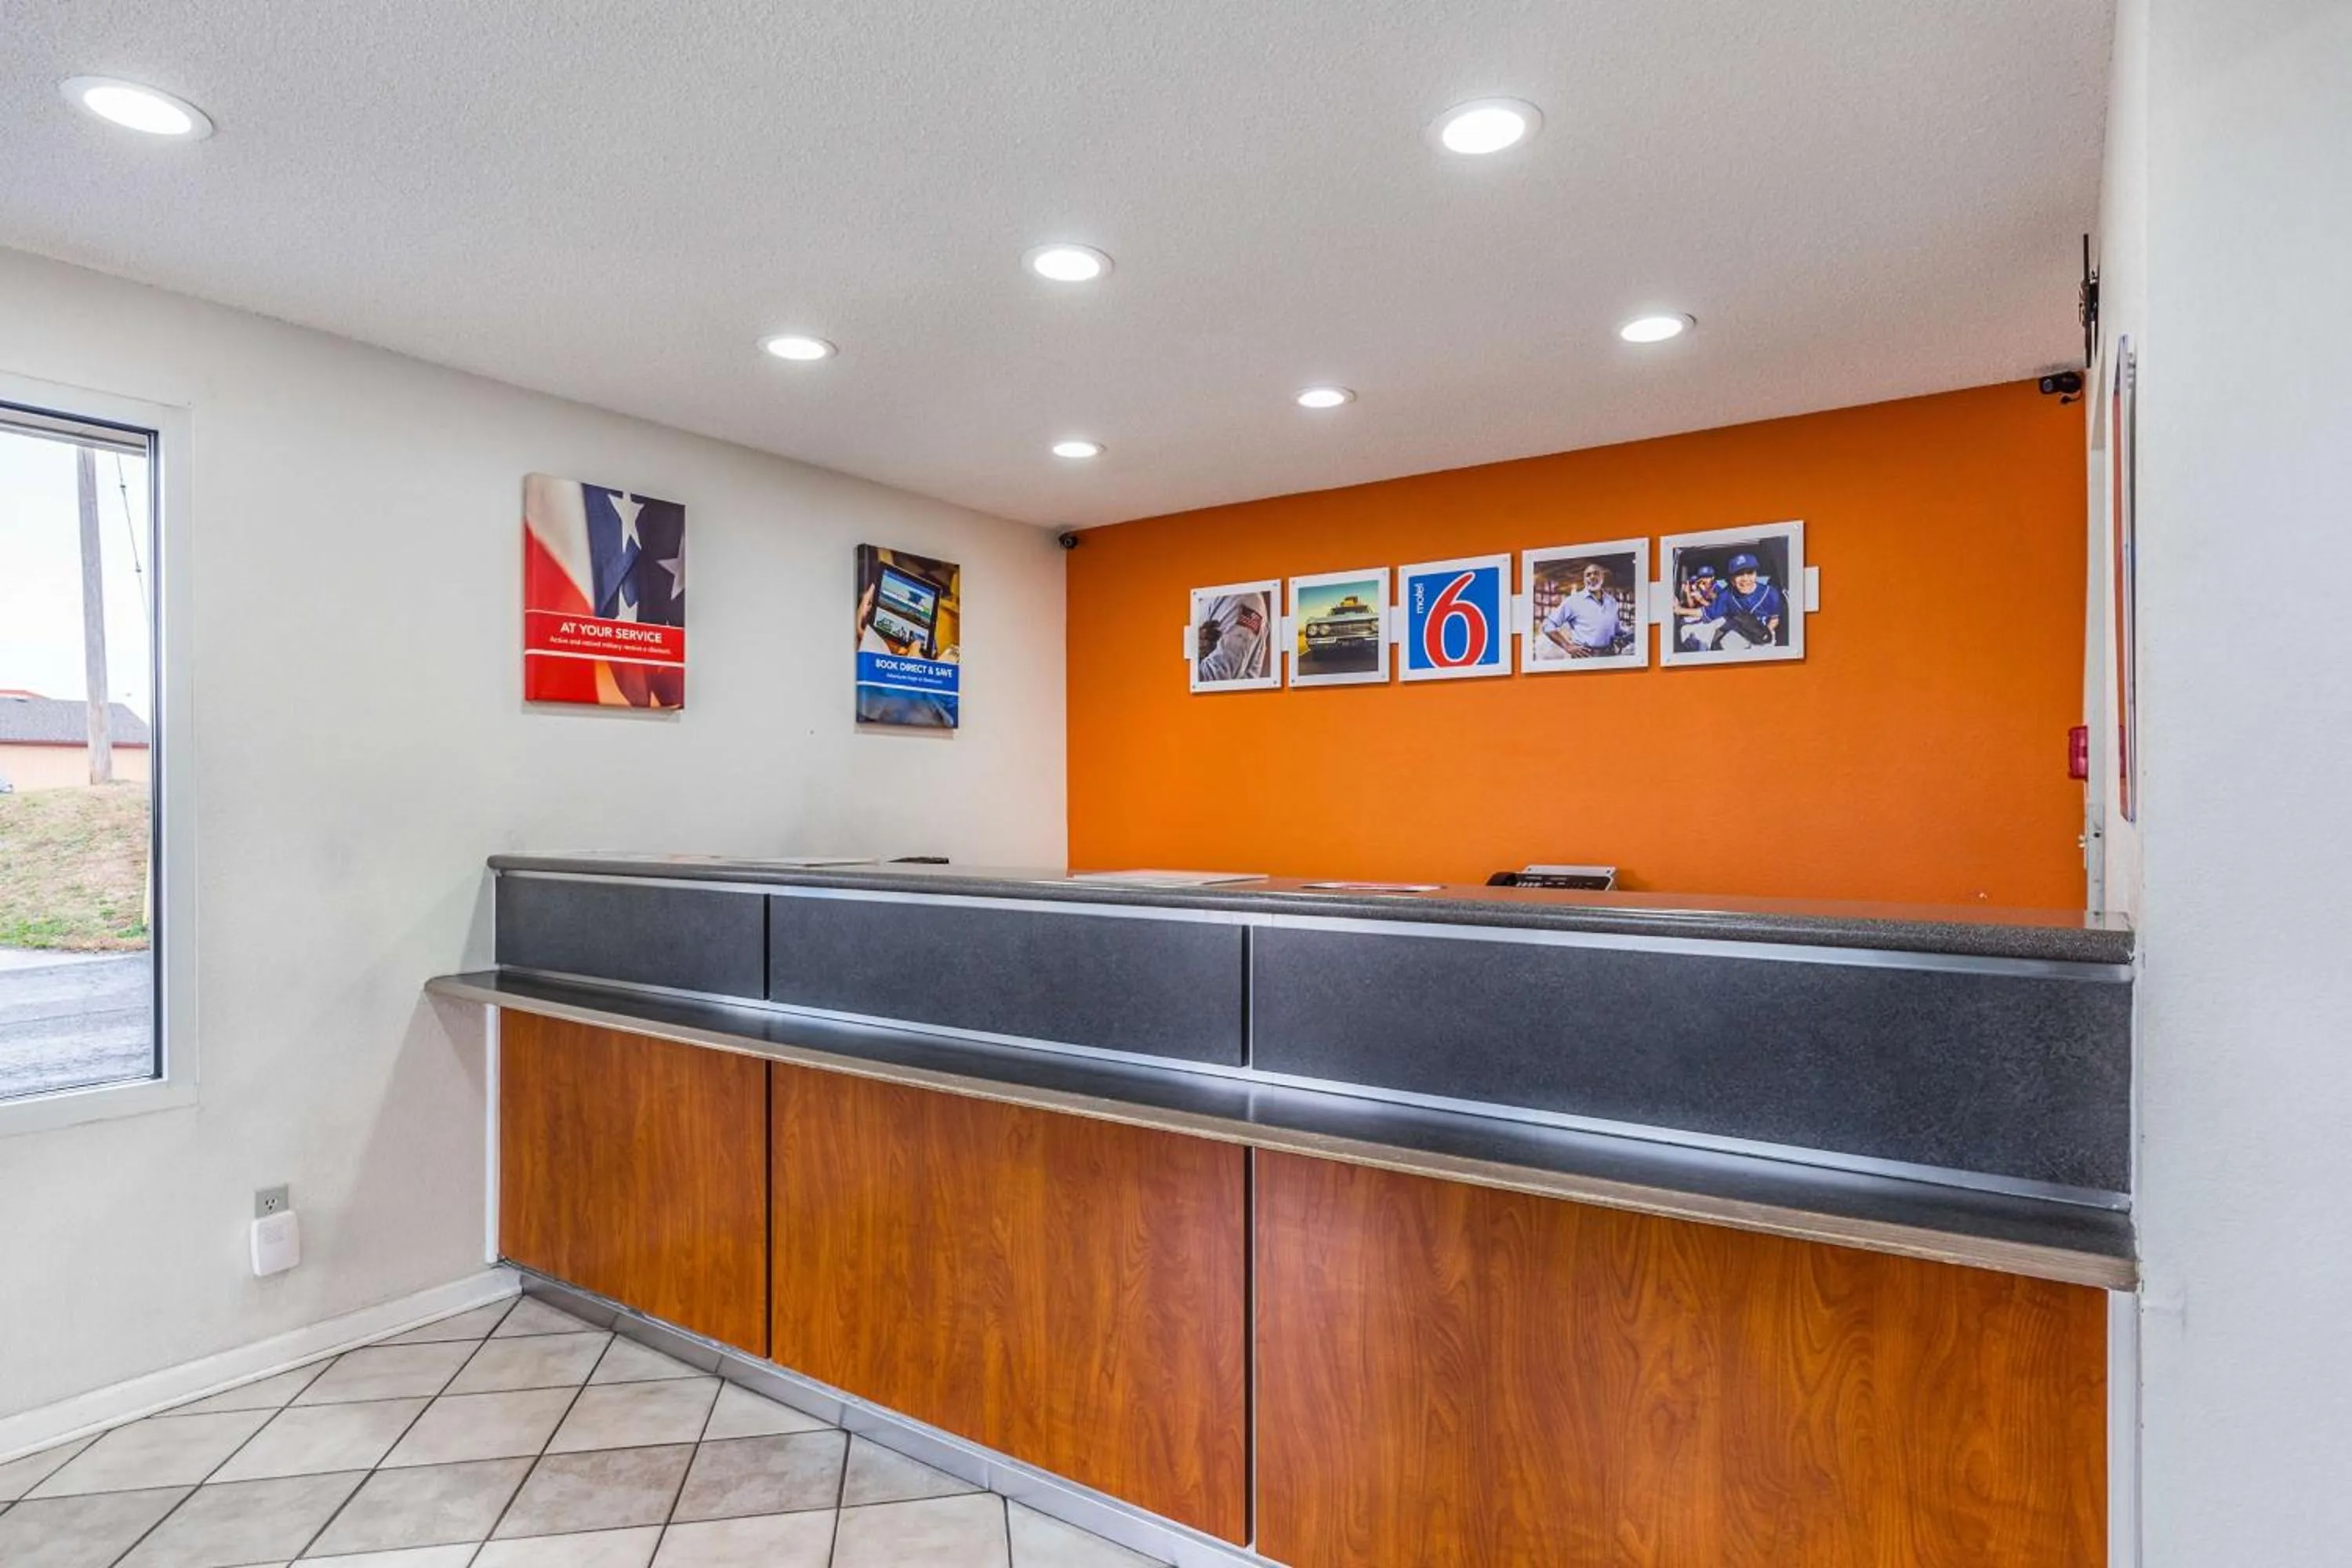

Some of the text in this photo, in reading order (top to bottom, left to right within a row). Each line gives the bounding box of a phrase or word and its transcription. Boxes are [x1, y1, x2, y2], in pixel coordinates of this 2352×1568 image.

[1414, 583, 1425, 614] motel
[560, 622, 662, 644] AT YOUR SERVICE
[1423, 572, 1488, 668] 6
[876, 659, 953, 678] BOOK DIRECT & SAVE
